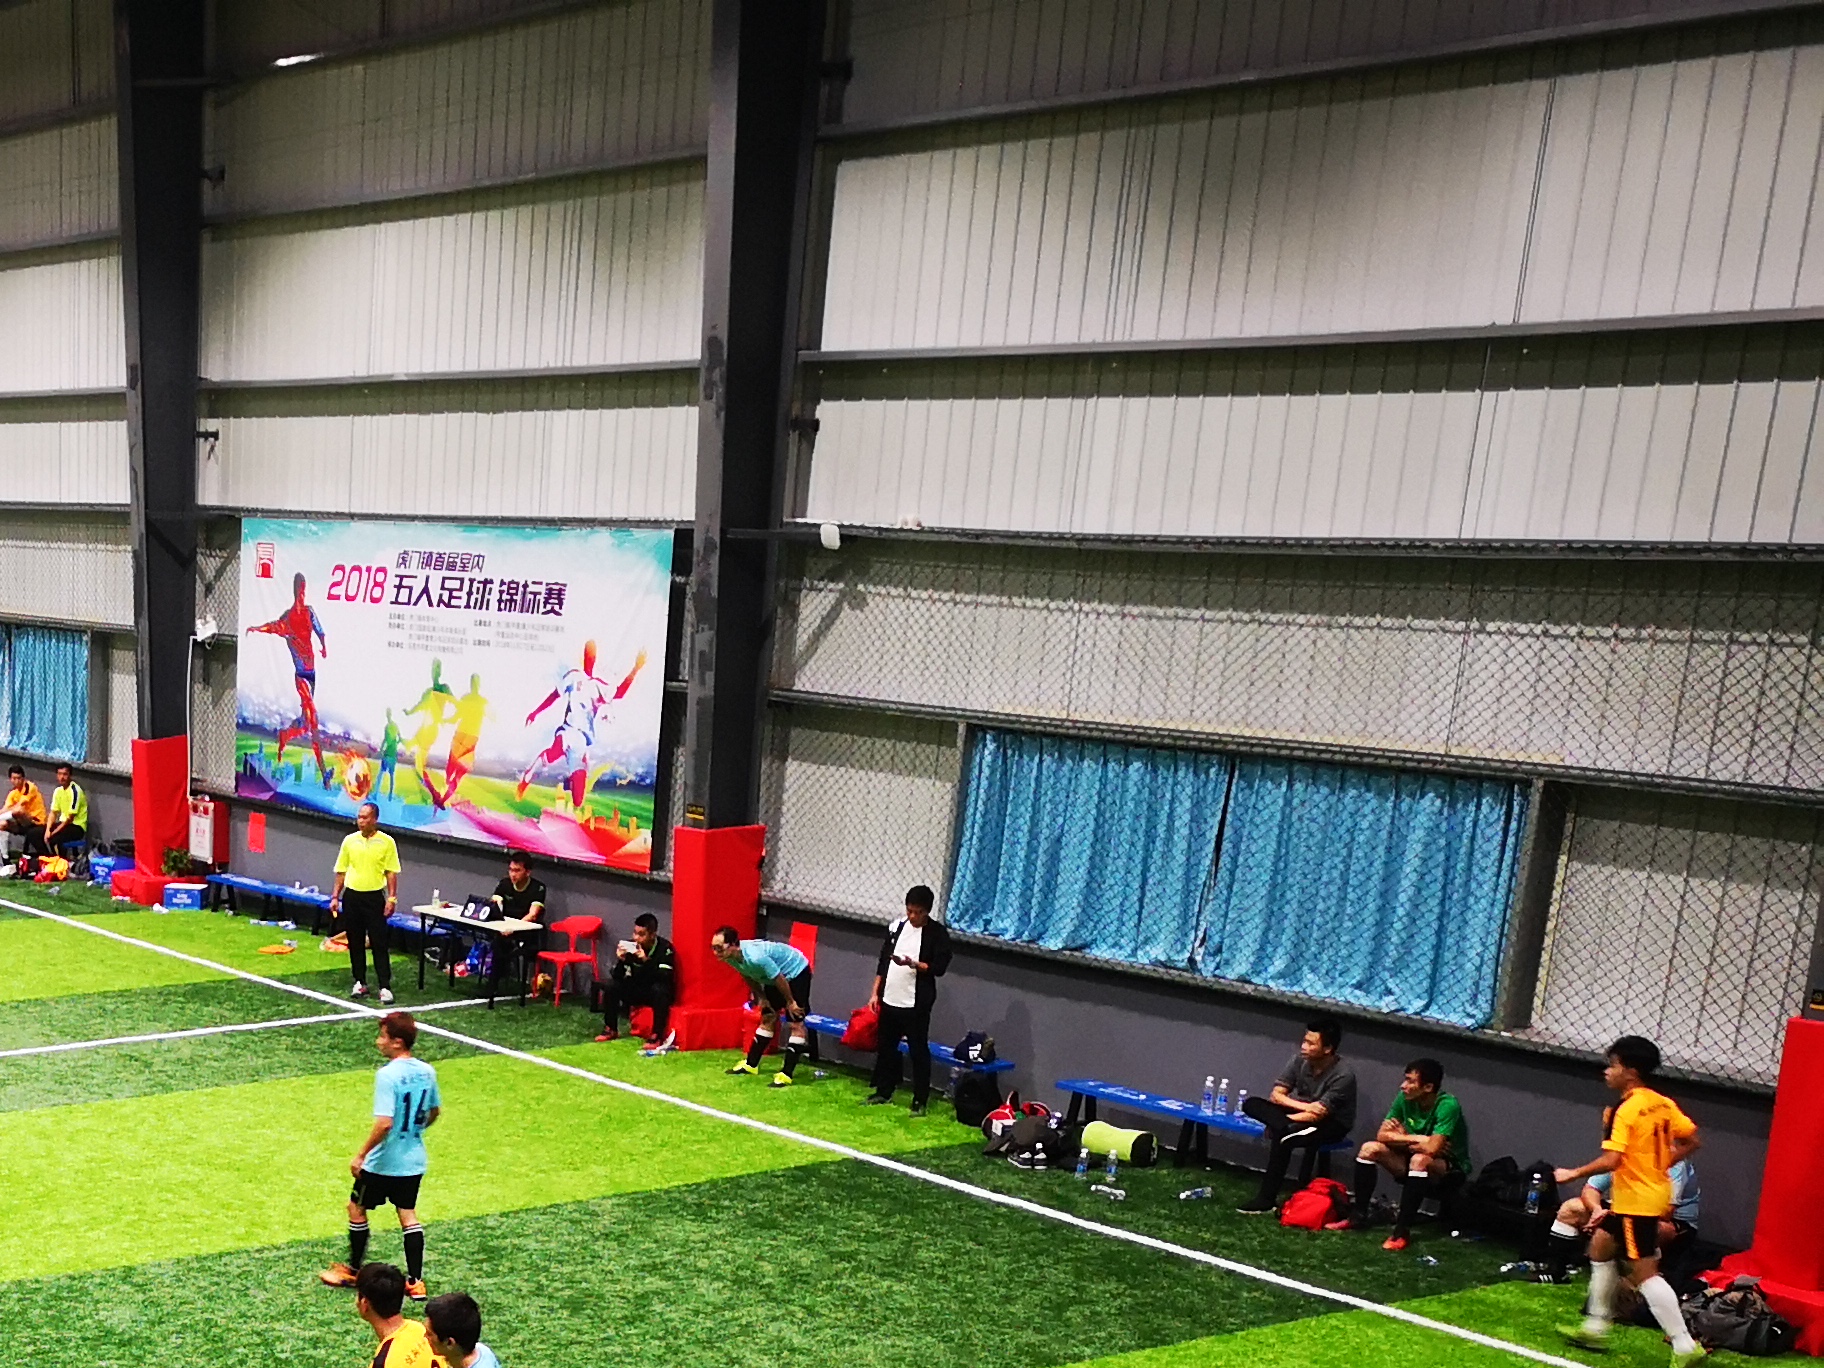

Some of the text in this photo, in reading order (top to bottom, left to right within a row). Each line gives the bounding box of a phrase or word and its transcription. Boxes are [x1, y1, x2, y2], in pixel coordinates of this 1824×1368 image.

[395, 550, 486, 573] 虎门镇首届室内
[327, 564, 388, 604] 2018
[479, 906, 490, 920] 0
